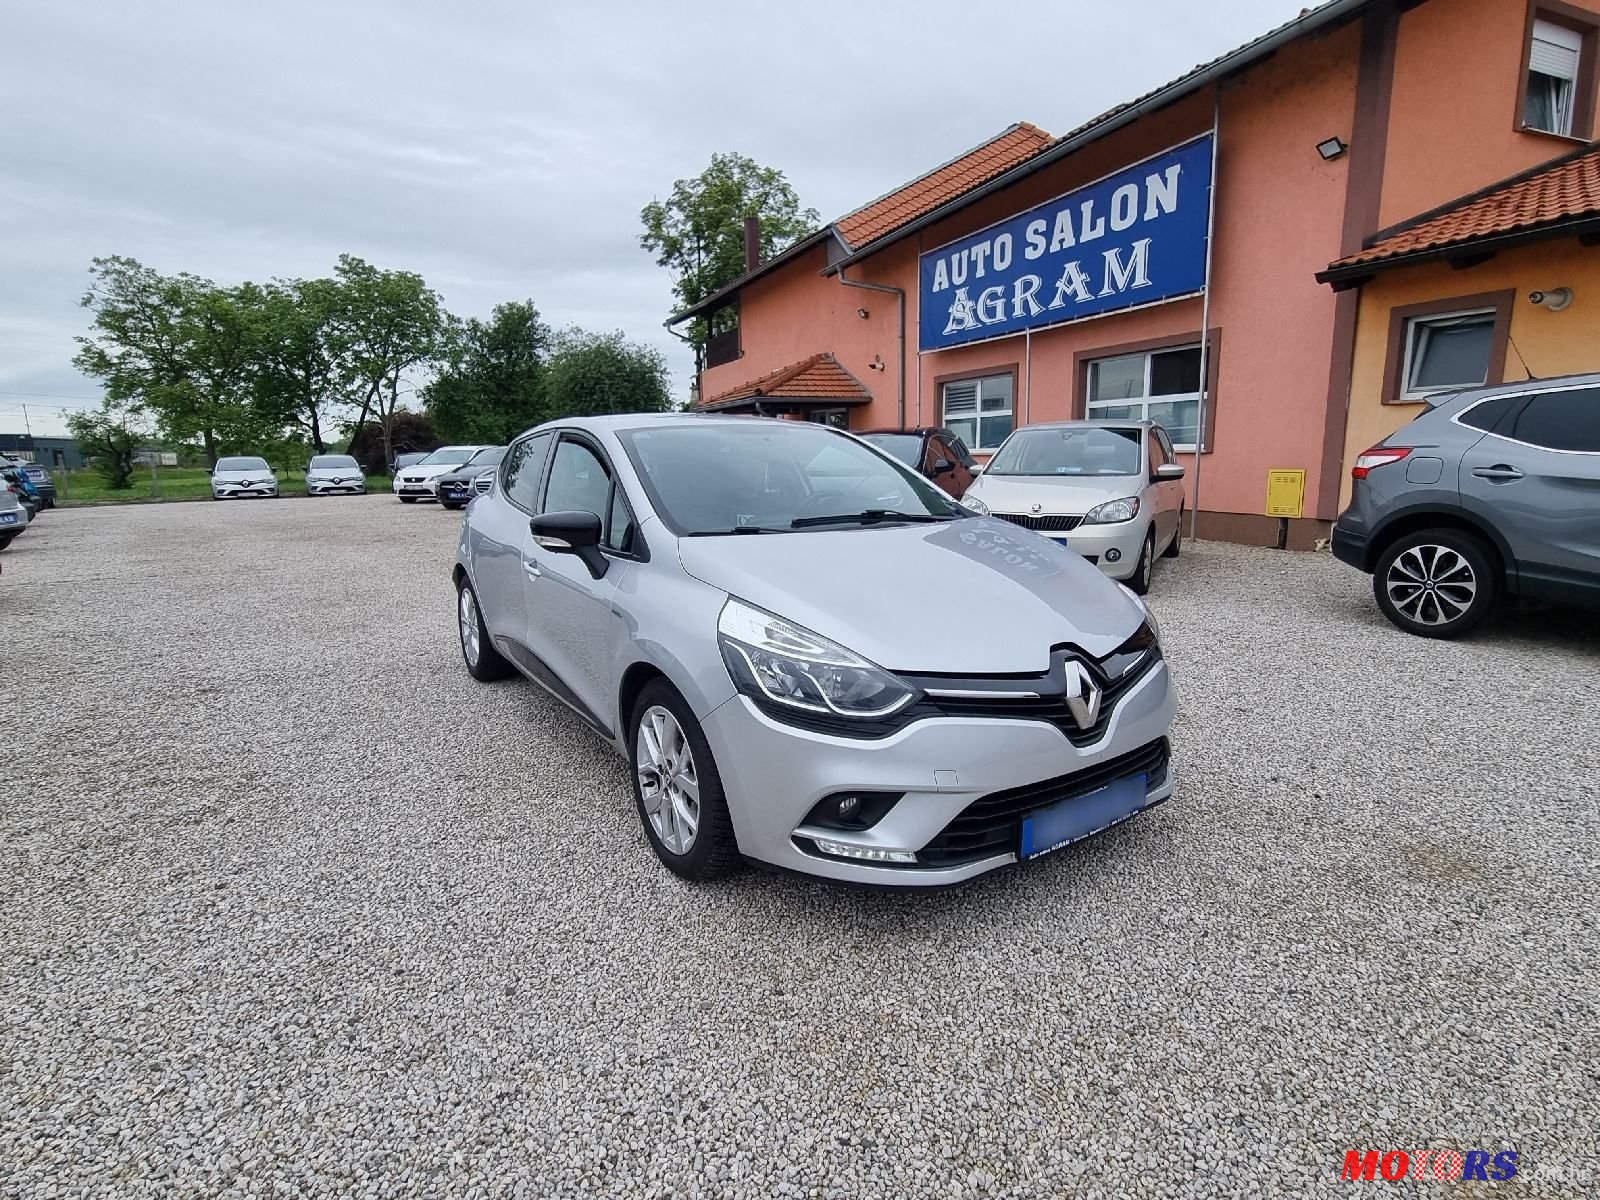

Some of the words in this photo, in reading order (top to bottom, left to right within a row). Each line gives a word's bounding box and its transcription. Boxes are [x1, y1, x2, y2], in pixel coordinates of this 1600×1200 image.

[932, 233, 1013, 293] AUTO
[1024, 163, 1182, 261] SALON
[942, 238, 1153, 336] AGRAM
